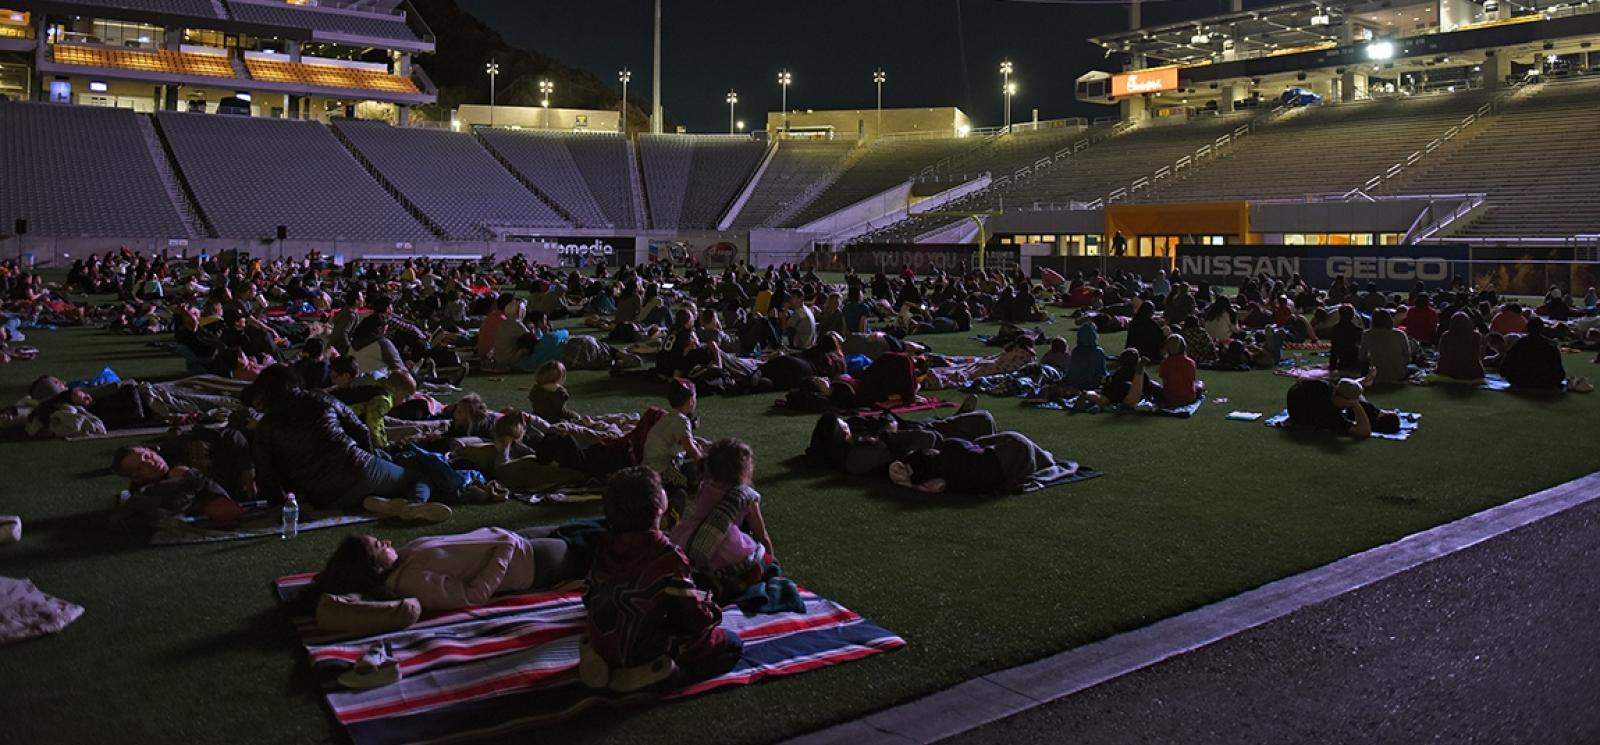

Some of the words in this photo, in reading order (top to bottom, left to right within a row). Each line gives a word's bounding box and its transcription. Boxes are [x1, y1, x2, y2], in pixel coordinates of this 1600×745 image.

[872, 250, 900, 267] YOU
[903, 250, 924, 267] DO
[927, 250, 957, 267] YOU
[1182, 255, 1300, 277] NISSAN
[1326, 257, 1448, 280] GEICO
